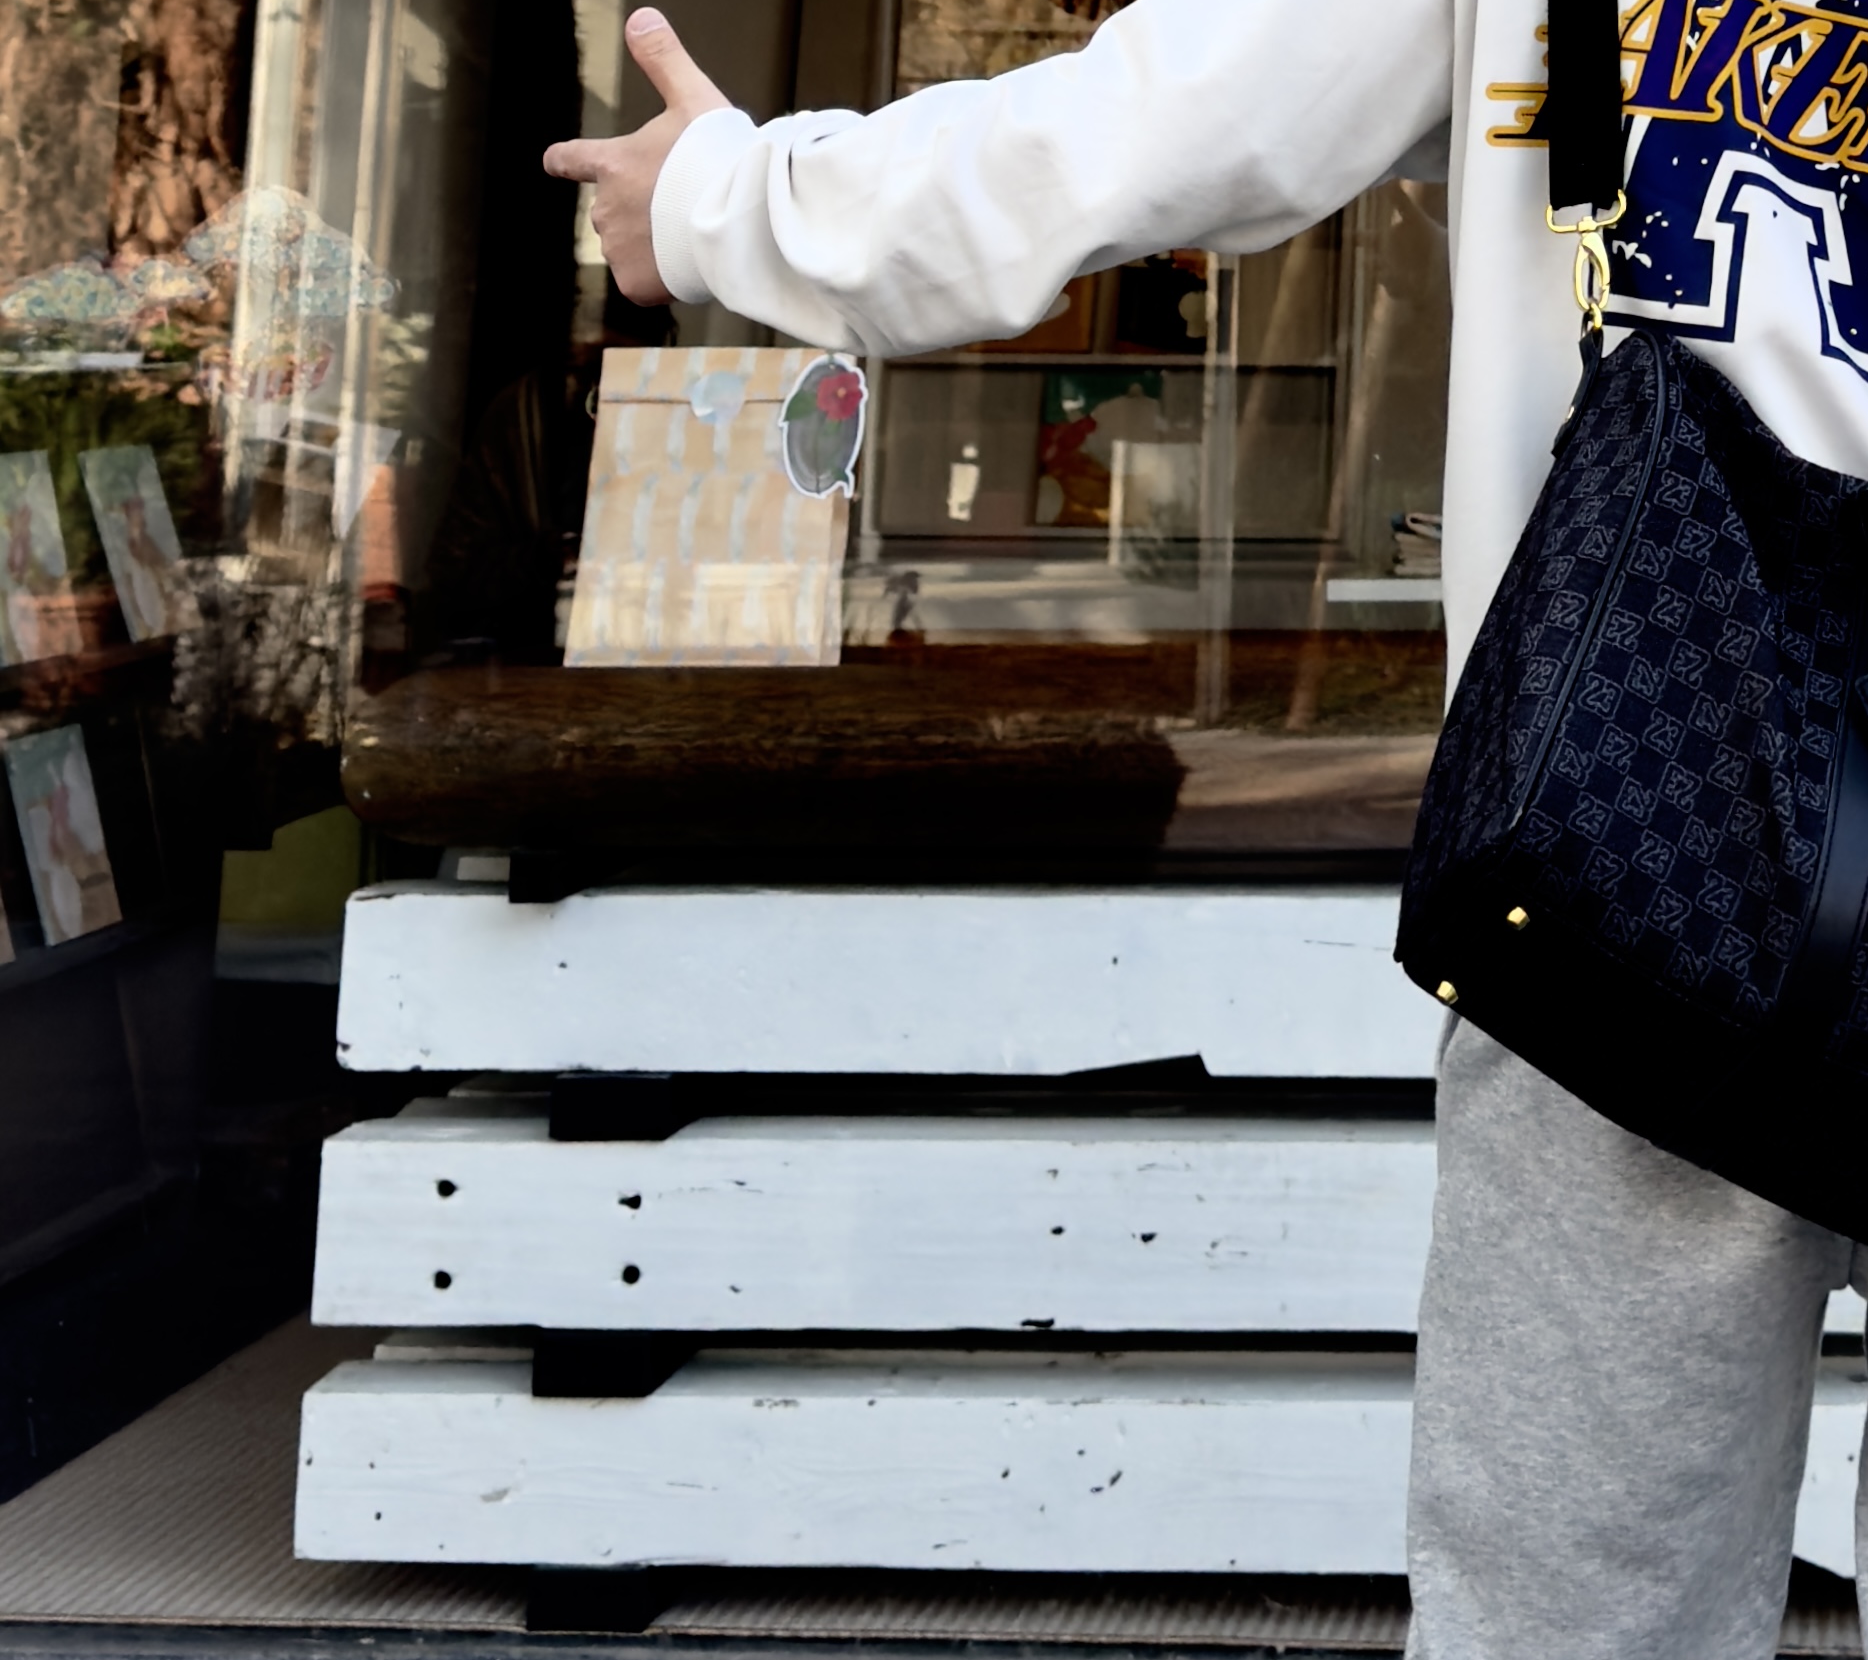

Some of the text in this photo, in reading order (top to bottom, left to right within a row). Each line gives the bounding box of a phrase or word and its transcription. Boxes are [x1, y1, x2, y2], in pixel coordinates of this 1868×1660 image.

[1654, 470, 1699, 515] 23
[1537, 556, 1576, 591] 23
[1649, 584, 1693, 635] 23
[1715, 618, 1760, 668] 23
[1781, 625, 1815, 667] 23
[1519, 656, 1562, 695] 23
[1578, 671, 1624, 721] 23
[1643, 707, 1687, 760] 23
[1800, 718, 1837, 759] 23
[1706, 744, 1751, 794] 23
[1567, 791, 1614, 842] 23
[1632, 829, 1678, 882] 23
[1696, 869, 1743, 922] 23
[1762, 906, 1800, 959] 23
